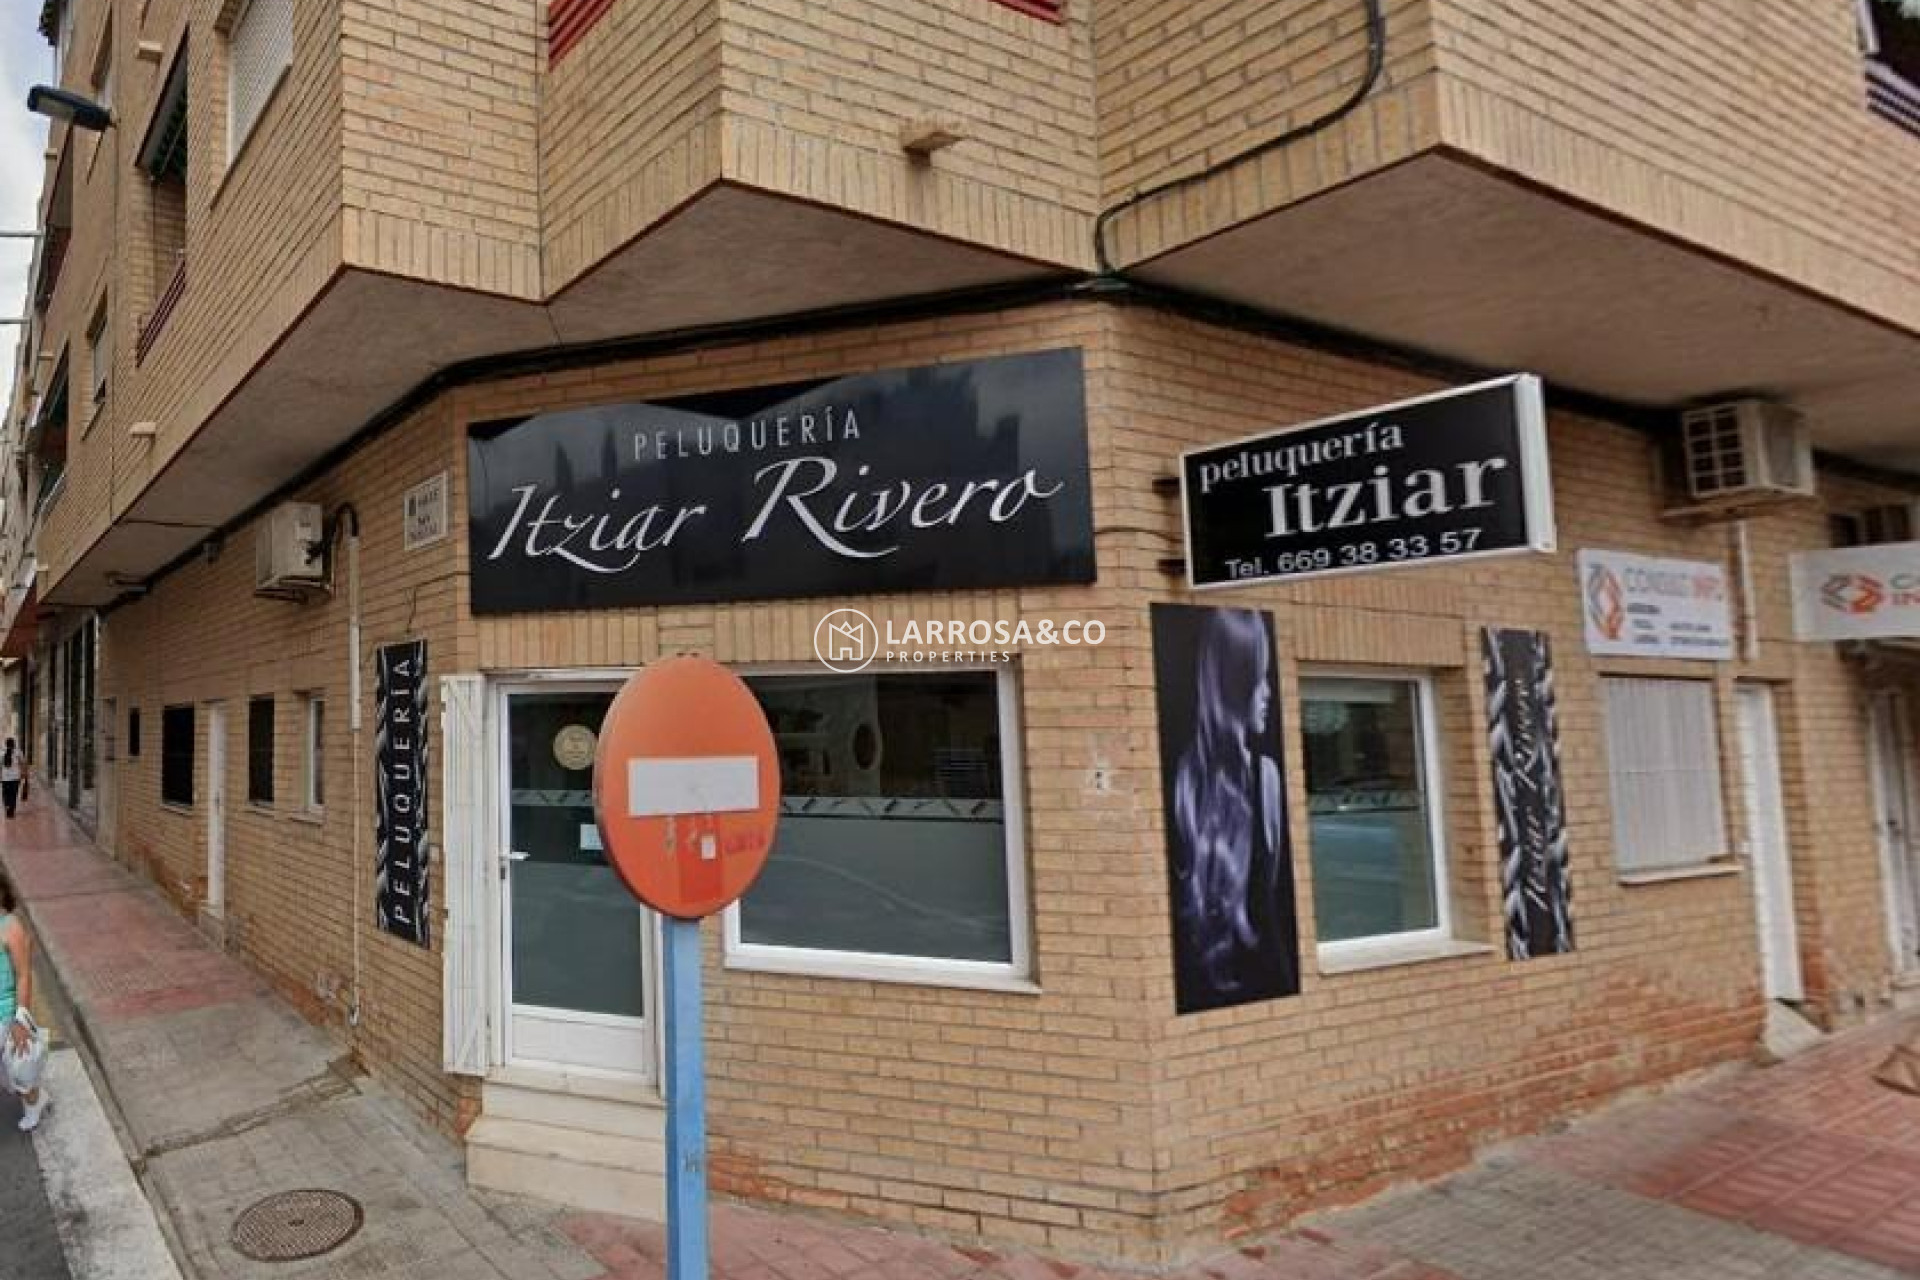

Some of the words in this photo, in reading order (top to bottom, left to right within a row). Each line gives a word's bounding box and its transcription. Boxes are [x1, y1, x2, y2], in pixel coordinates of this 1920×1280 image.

[634, 405, 861, 461] PELUQUERÍA
[1200, 421, 1405, 493] peluquería
[488, 484, 708, 574] Itziar
[741, 456, 1065, 558] Rivero
[1261, 457, 1507, 539] Itziar
[1224, 557, 1270, 580] Tel.
[1277, 547, 1331, 574] 669
[1339, 541, 1379, 566] 38
[1388, 534, 1431, 559] 33
[1439, 527, 1483, 554] 57
[390, 659, 411, 924] PELUQUERÍA
